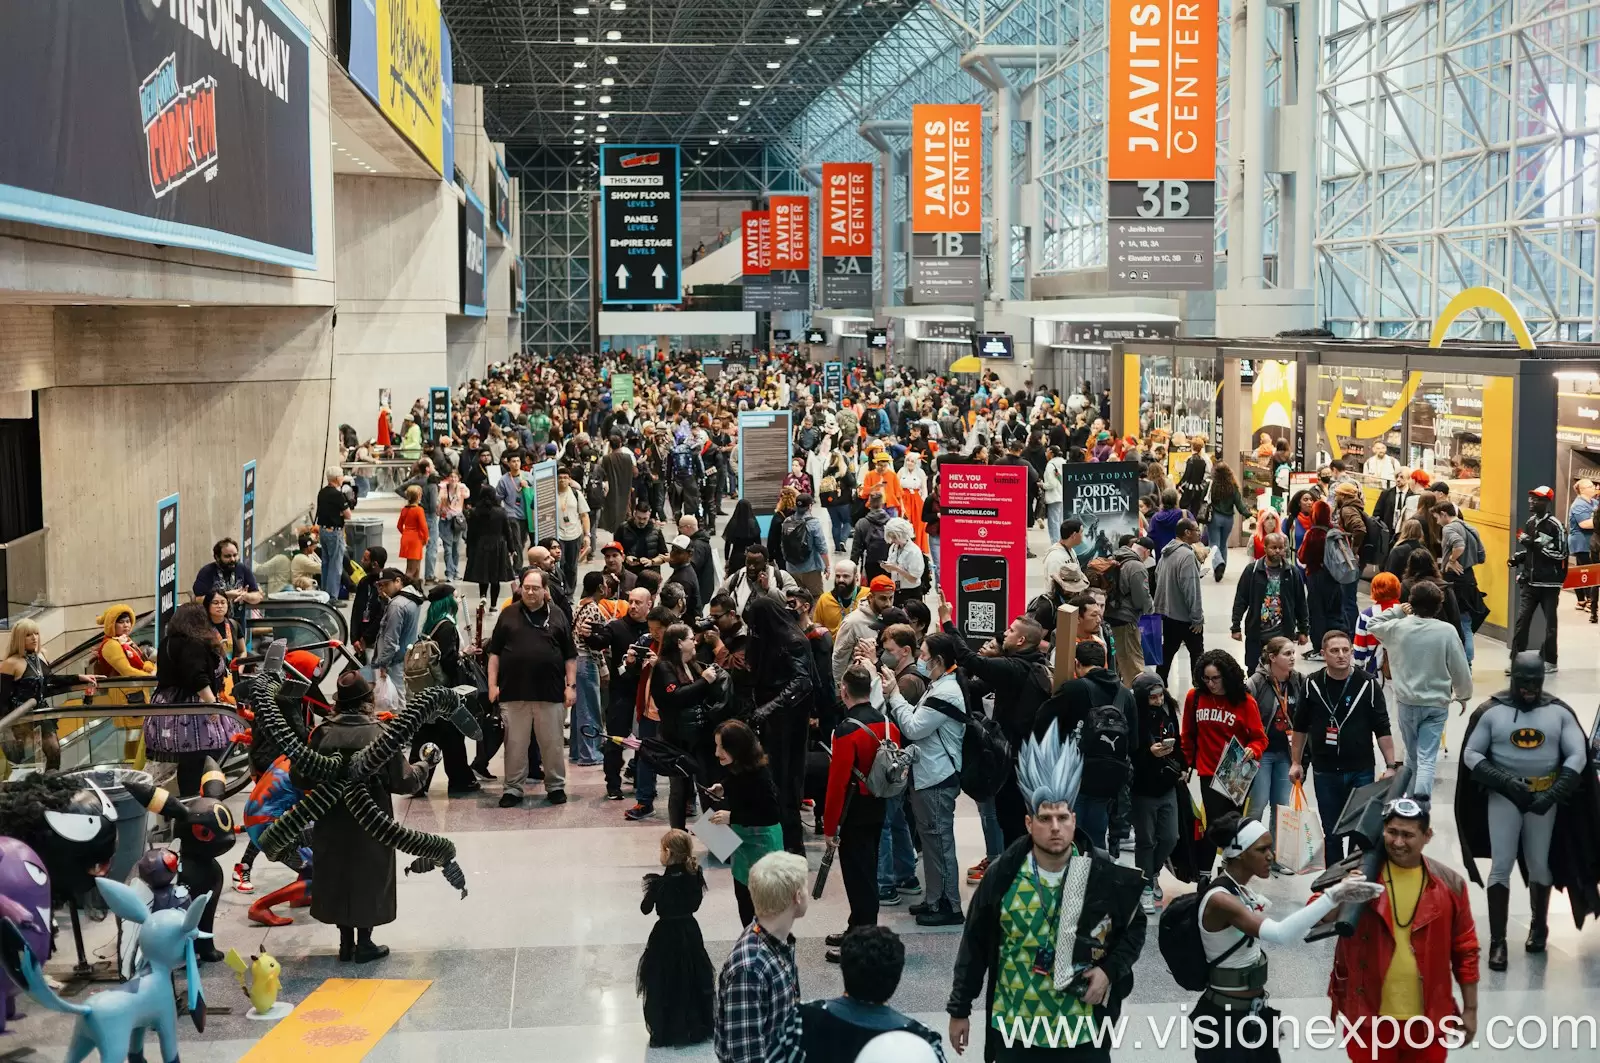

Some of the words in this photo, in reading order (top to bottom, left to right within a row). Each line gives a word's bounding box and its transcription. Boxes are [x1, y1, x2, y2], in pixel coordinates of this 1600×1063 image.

[246, 6, 257, 80] &
[257, 19, 290, 104] ONLY
[1128, 4, 1161, 152] JAVITS
[1173, 3, 1200, 154] CENTER
[924, 121, 946, 215] JAVITS
[953, 120, 970, 216] CENTER
[610, 192, 638, 200] SHOW
[1136, 181, 1190, 218] 3B
[624, 215, 659, 223] PANELS
[831, 174, 846, 244] JAVITS
[852, 174, 865, 244] CENTER
[610, 239, 644, 247] EMPIRE
[644, 239, 673, 247] STAGE
[747, 219, 758, 266] JAVITS
[761, 218, 771, 267] CENTER
[776, 205, 789, 260] JAVITS
[793, 205, 804, 261] CENTER
[931, 233, 964, 257] 1B
[780, 270, 800, 284] 1A
[834, 256, 861, 275] 3A
[1144, 368, 1183, 405] Shopping
[1184, 372, 1217, 402] withou
[1434, 395, 1452, 415] Just
[433, 422, 448, 430] FLOOR
[1154, 404, 1168, 430] the
[1432, 417, 1454, 438] Walk
[1434, 439, 1452, 460] Out
[1067, 474, 1093, 482] PLAY
[1099, 472, 1134, 480] TODAY
[1076, 484, 1116, 498] LORDS
[1072, 495, 1130, 515] FALLEN
[159, 564, 176, 587] QUEUE
[161, 591, 174, 614] HALL
[1195, 708, 1210, 723] FOR
[1210, 708, 1237, 727] DAYS
